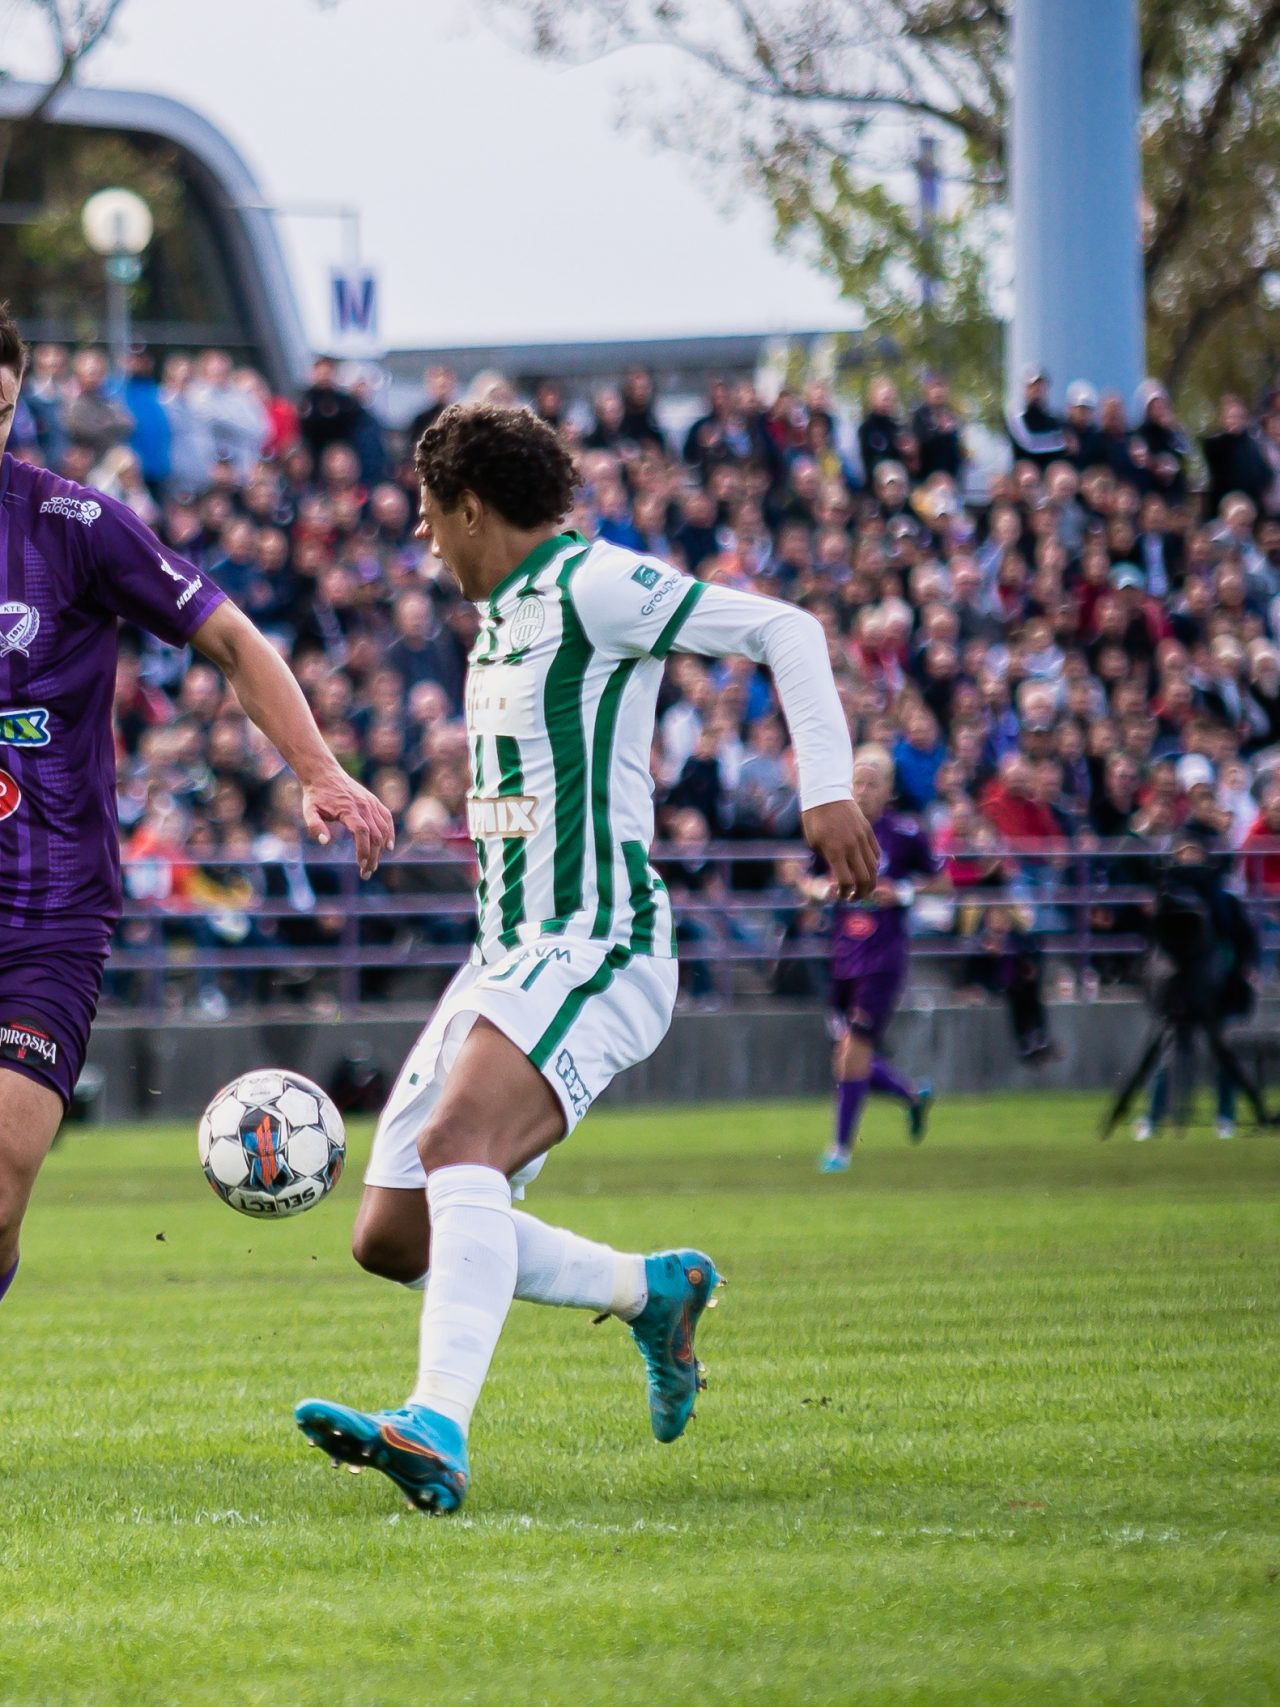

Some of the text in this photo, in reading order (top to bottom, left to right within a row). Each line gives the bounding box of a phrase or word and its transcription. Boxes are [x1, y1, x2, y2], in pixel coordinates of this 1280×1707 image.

[40, 501, 94, 527] Budapest
[3, 605, 22, 613] KTE
[9, 623, 26, 640] 1911
[239, 1186, 316, 1213] SELECT
